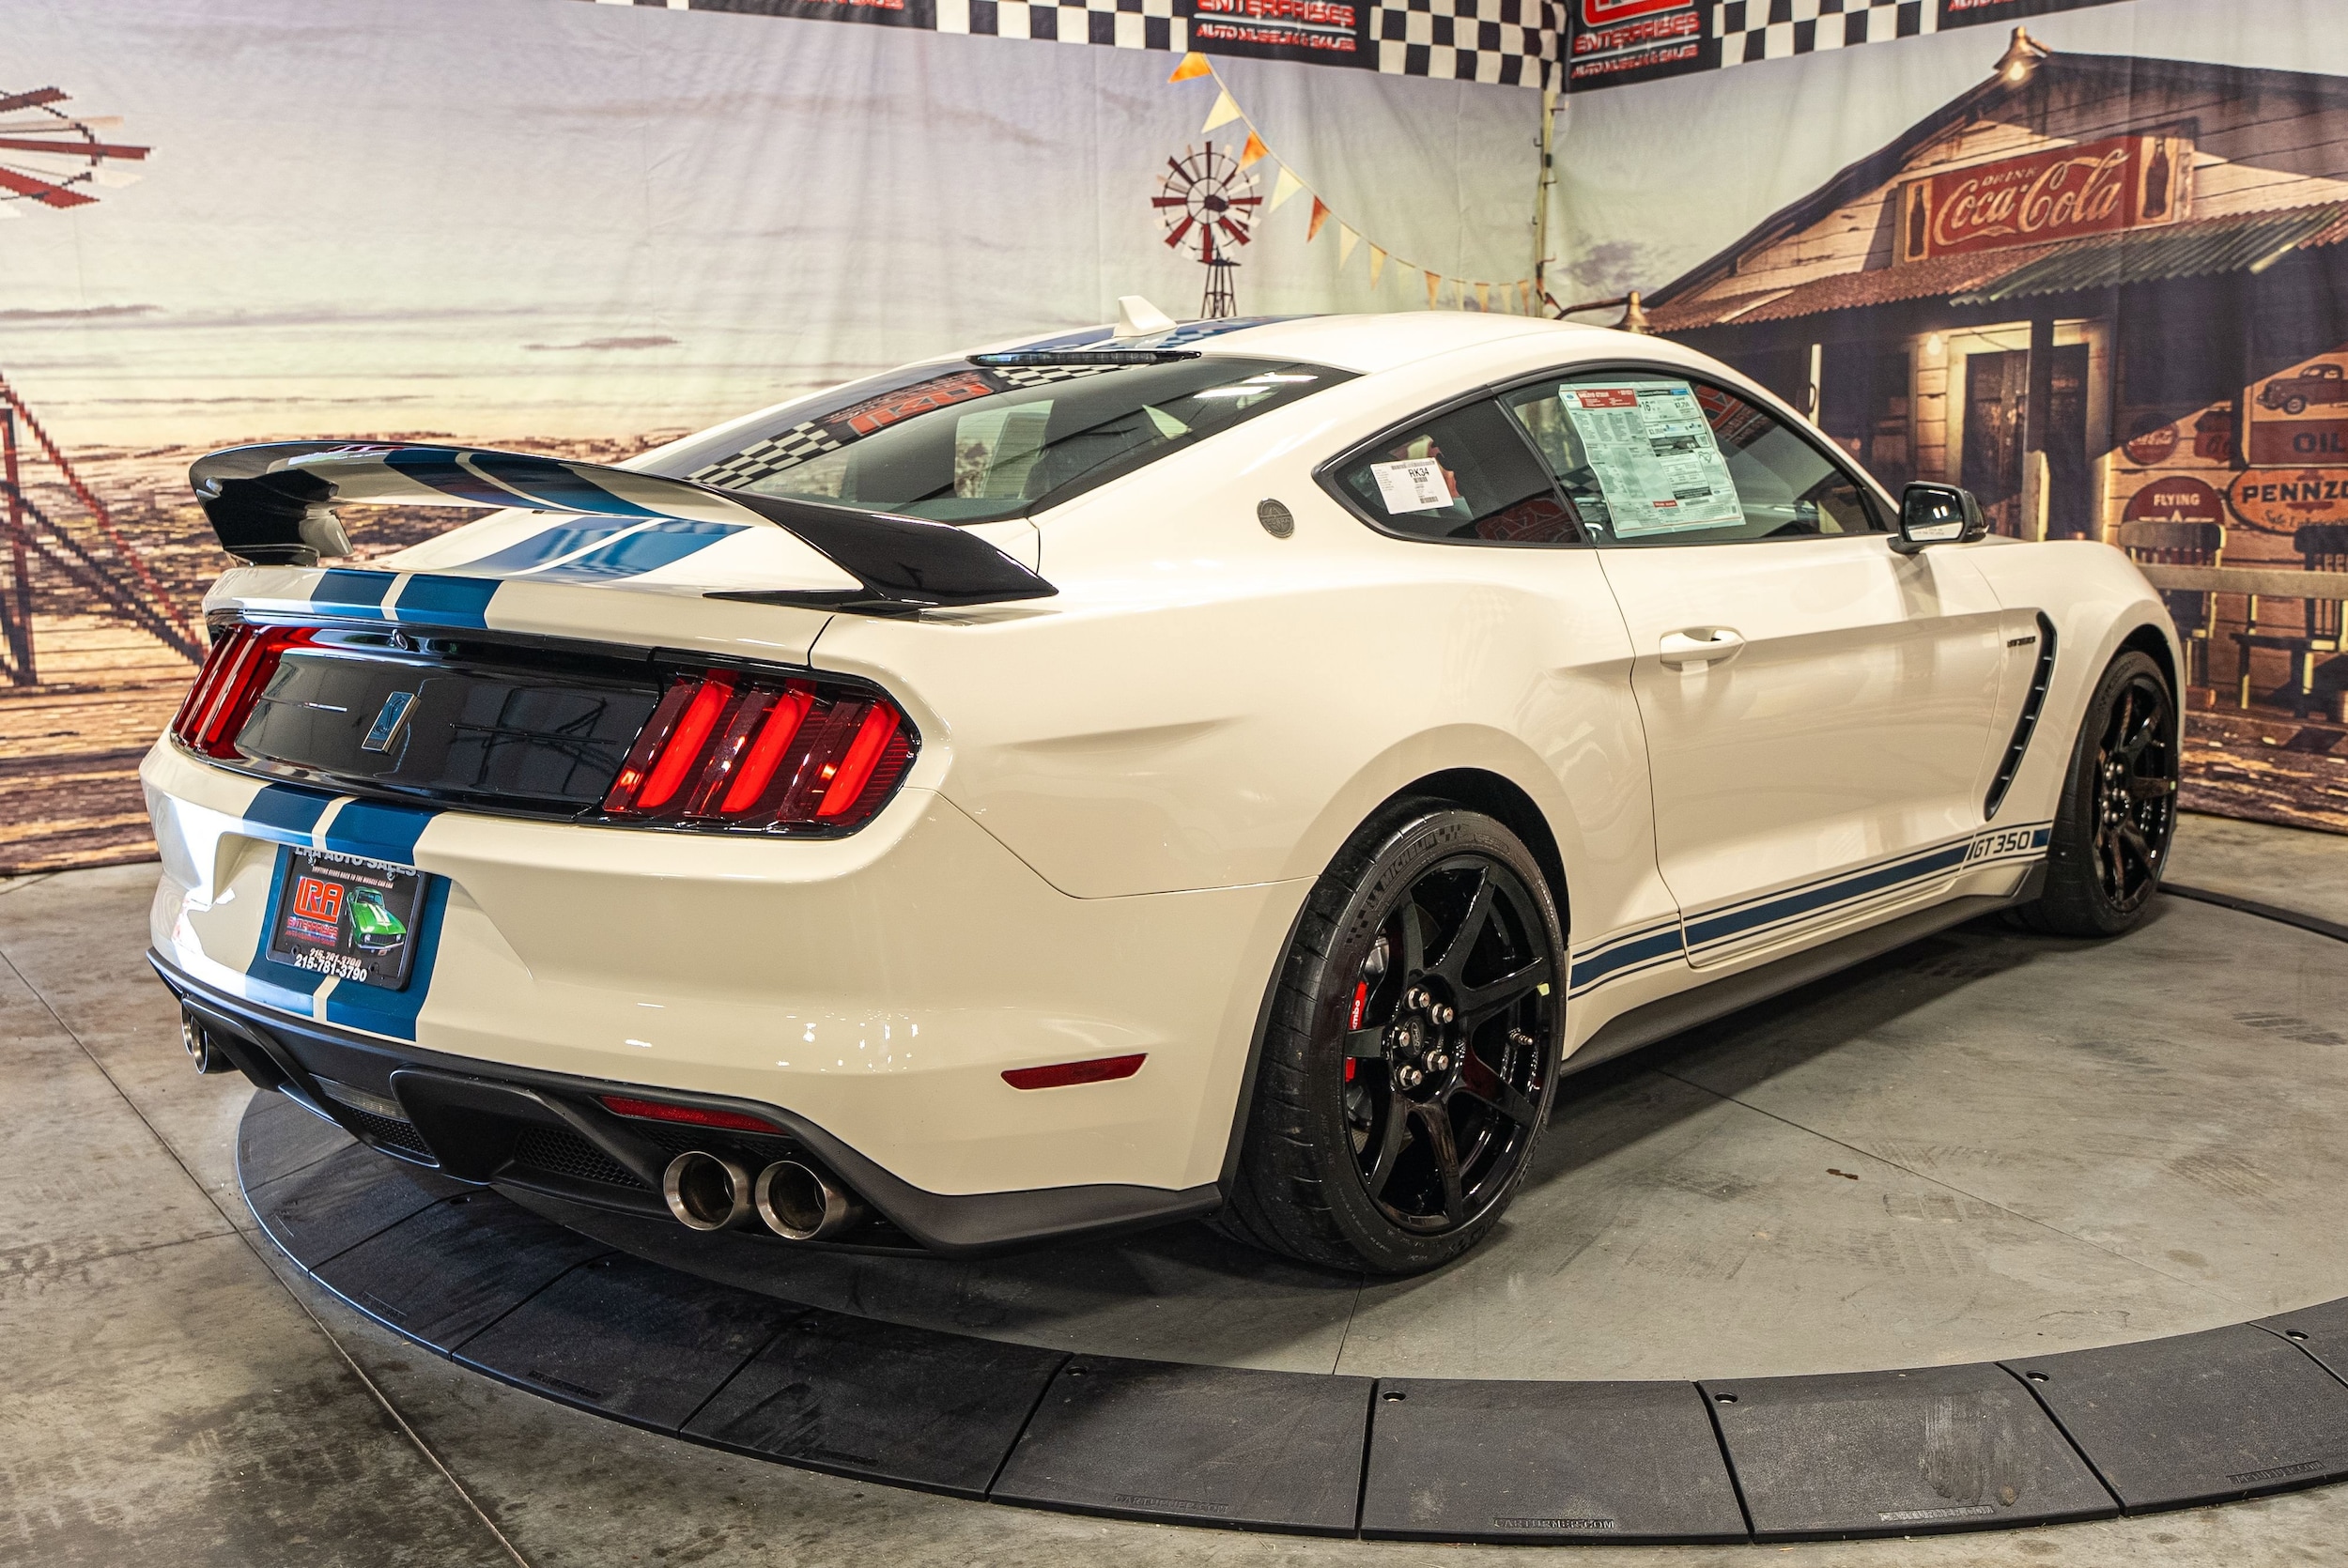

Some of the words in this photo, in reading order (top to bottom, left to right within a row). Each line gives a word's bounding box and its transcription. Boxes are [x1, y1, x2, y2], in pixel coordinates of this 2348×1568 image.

[1197, 23, 1237, 38] AUTO
[1574, 11, 1700, 54] ENTERPRISES
[1981, 166, 2039, 187] DRINK
[2293, 433, 2344, 453] OIL
[1409, 468, 1429, 478] RK34
[2154, 493, 2200, 506] FLYING
[1973, 830, 2030, 858] GT350
[324, 852, 363, 866] AUTO
[1380, 832, 1436, 890] MICHELIN
[293, 876, 345, 925] LRA
[294, 954, 367, 982] 215-781-3790
